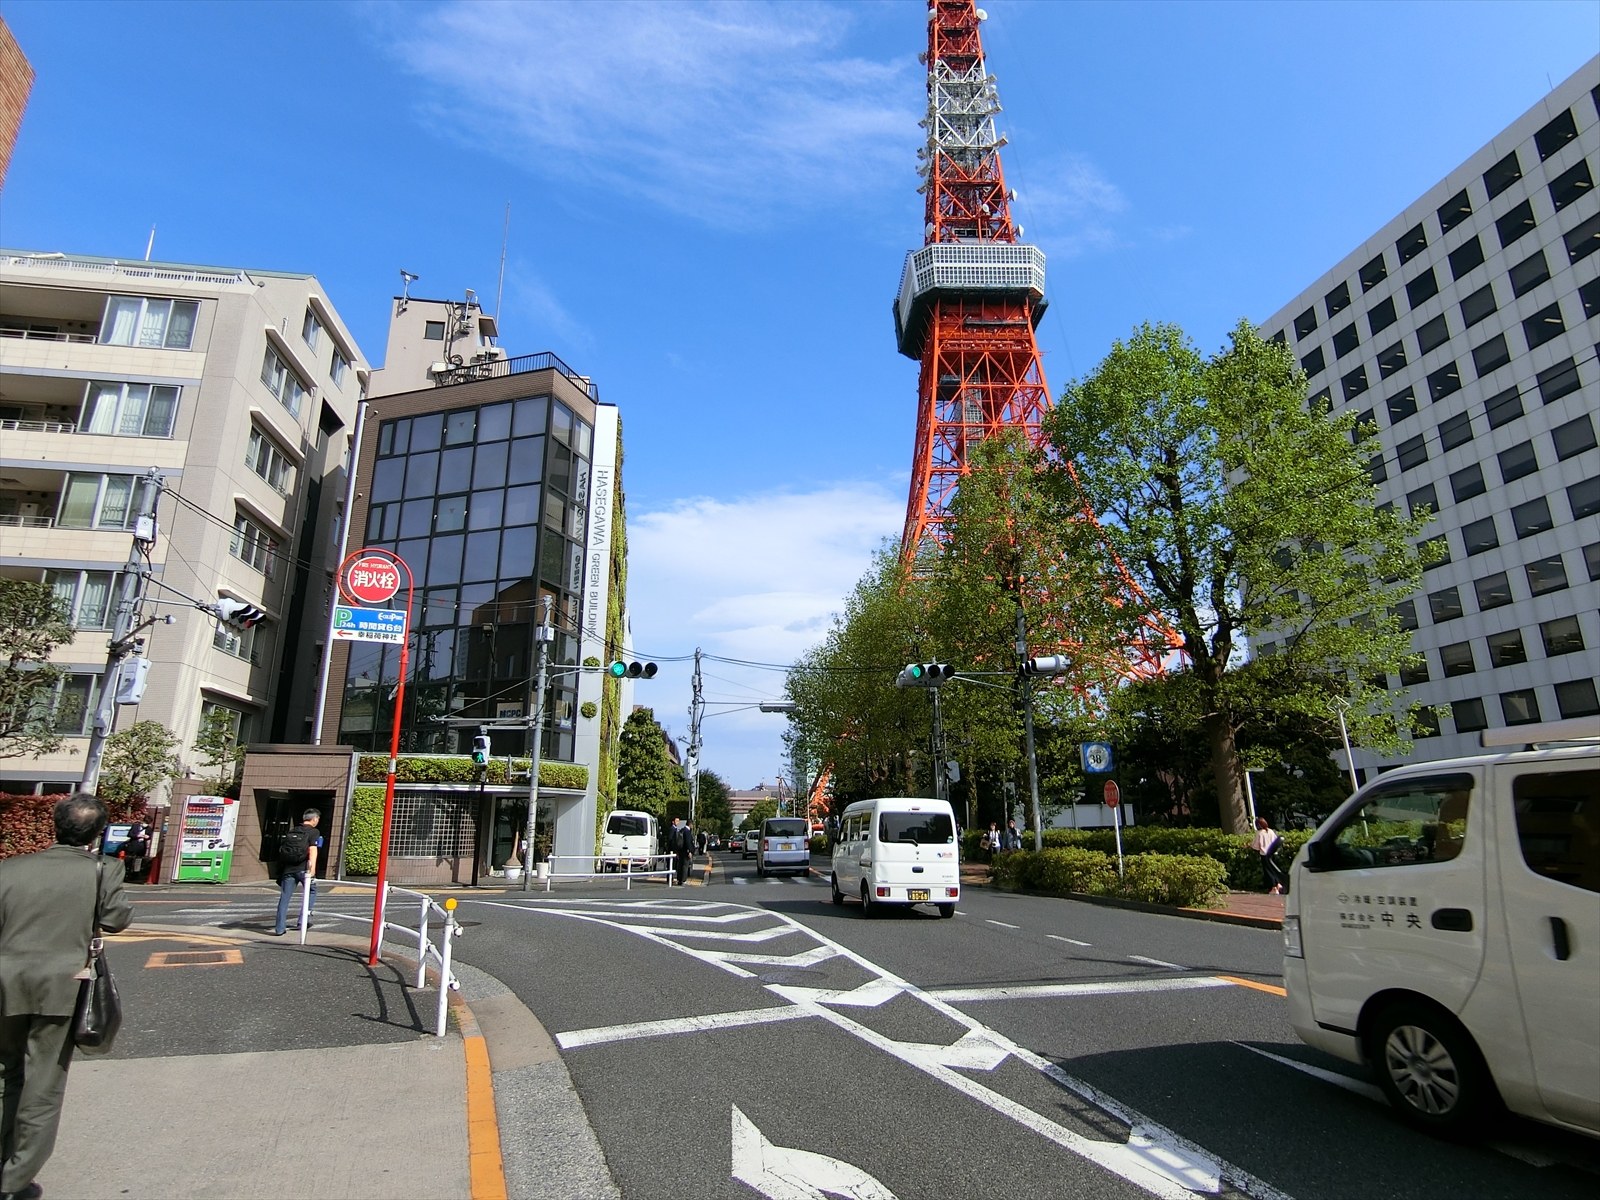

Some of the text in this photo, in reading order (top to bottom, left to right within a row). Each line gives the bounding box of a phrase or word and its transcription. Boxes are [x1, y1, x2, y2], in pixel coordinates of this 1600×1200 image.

[592, 470, 609, 546] HASEGAWA
[353, 569, 396, 589] 消火栓
[590, 553, 600, 588] GREEN
[335, 609, 352, 627] P
[359, 621, 402, 632] 時間貸6台
[500, 709, 521, 718] MCPC
[1090, 754, 1101, 764] 38
[1381, 911, 1423, 930] 中央
